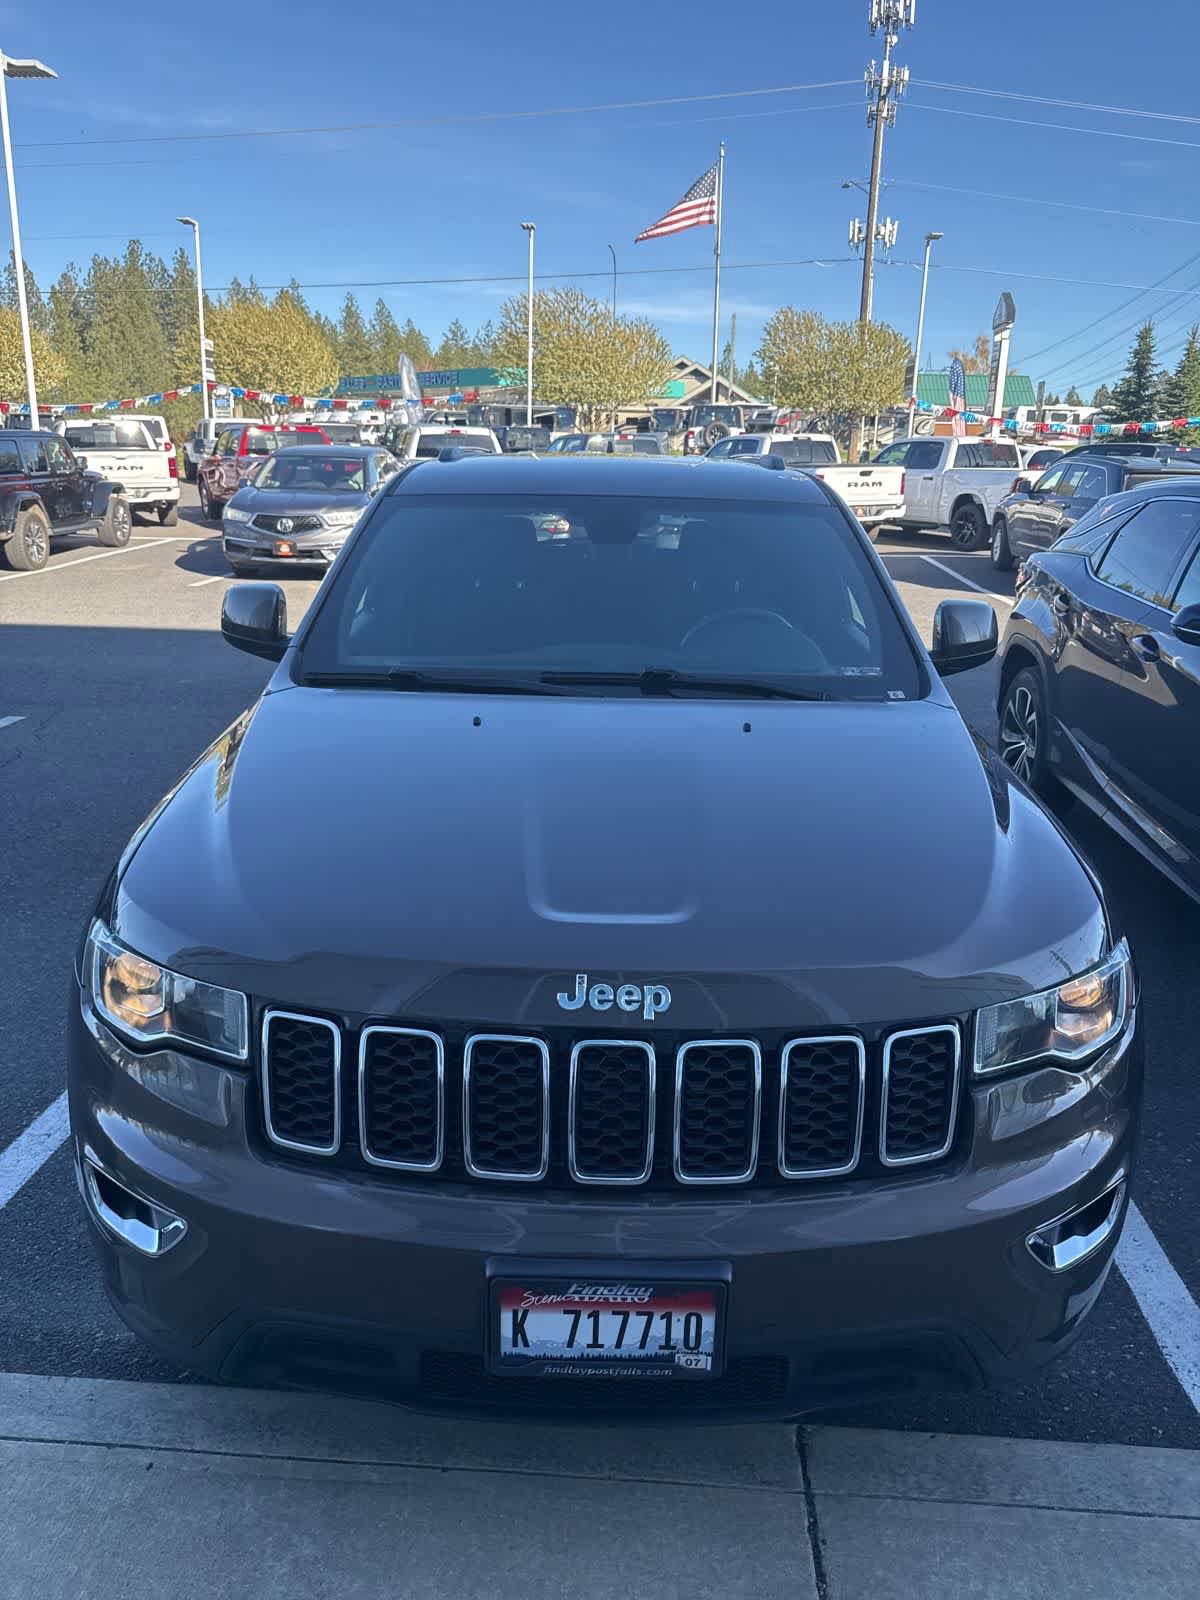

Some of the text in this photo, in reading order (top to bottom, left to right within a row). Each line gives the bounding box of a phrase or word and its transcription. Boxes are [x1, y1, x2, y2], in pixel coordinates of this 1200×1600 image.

[557, 973, 671, 1020] Jeep
[566, 1282, 654, 1300] Findlay
[511, 1309, 703, 1351] K 717710
[685, 1358, 701, 1367] 07
